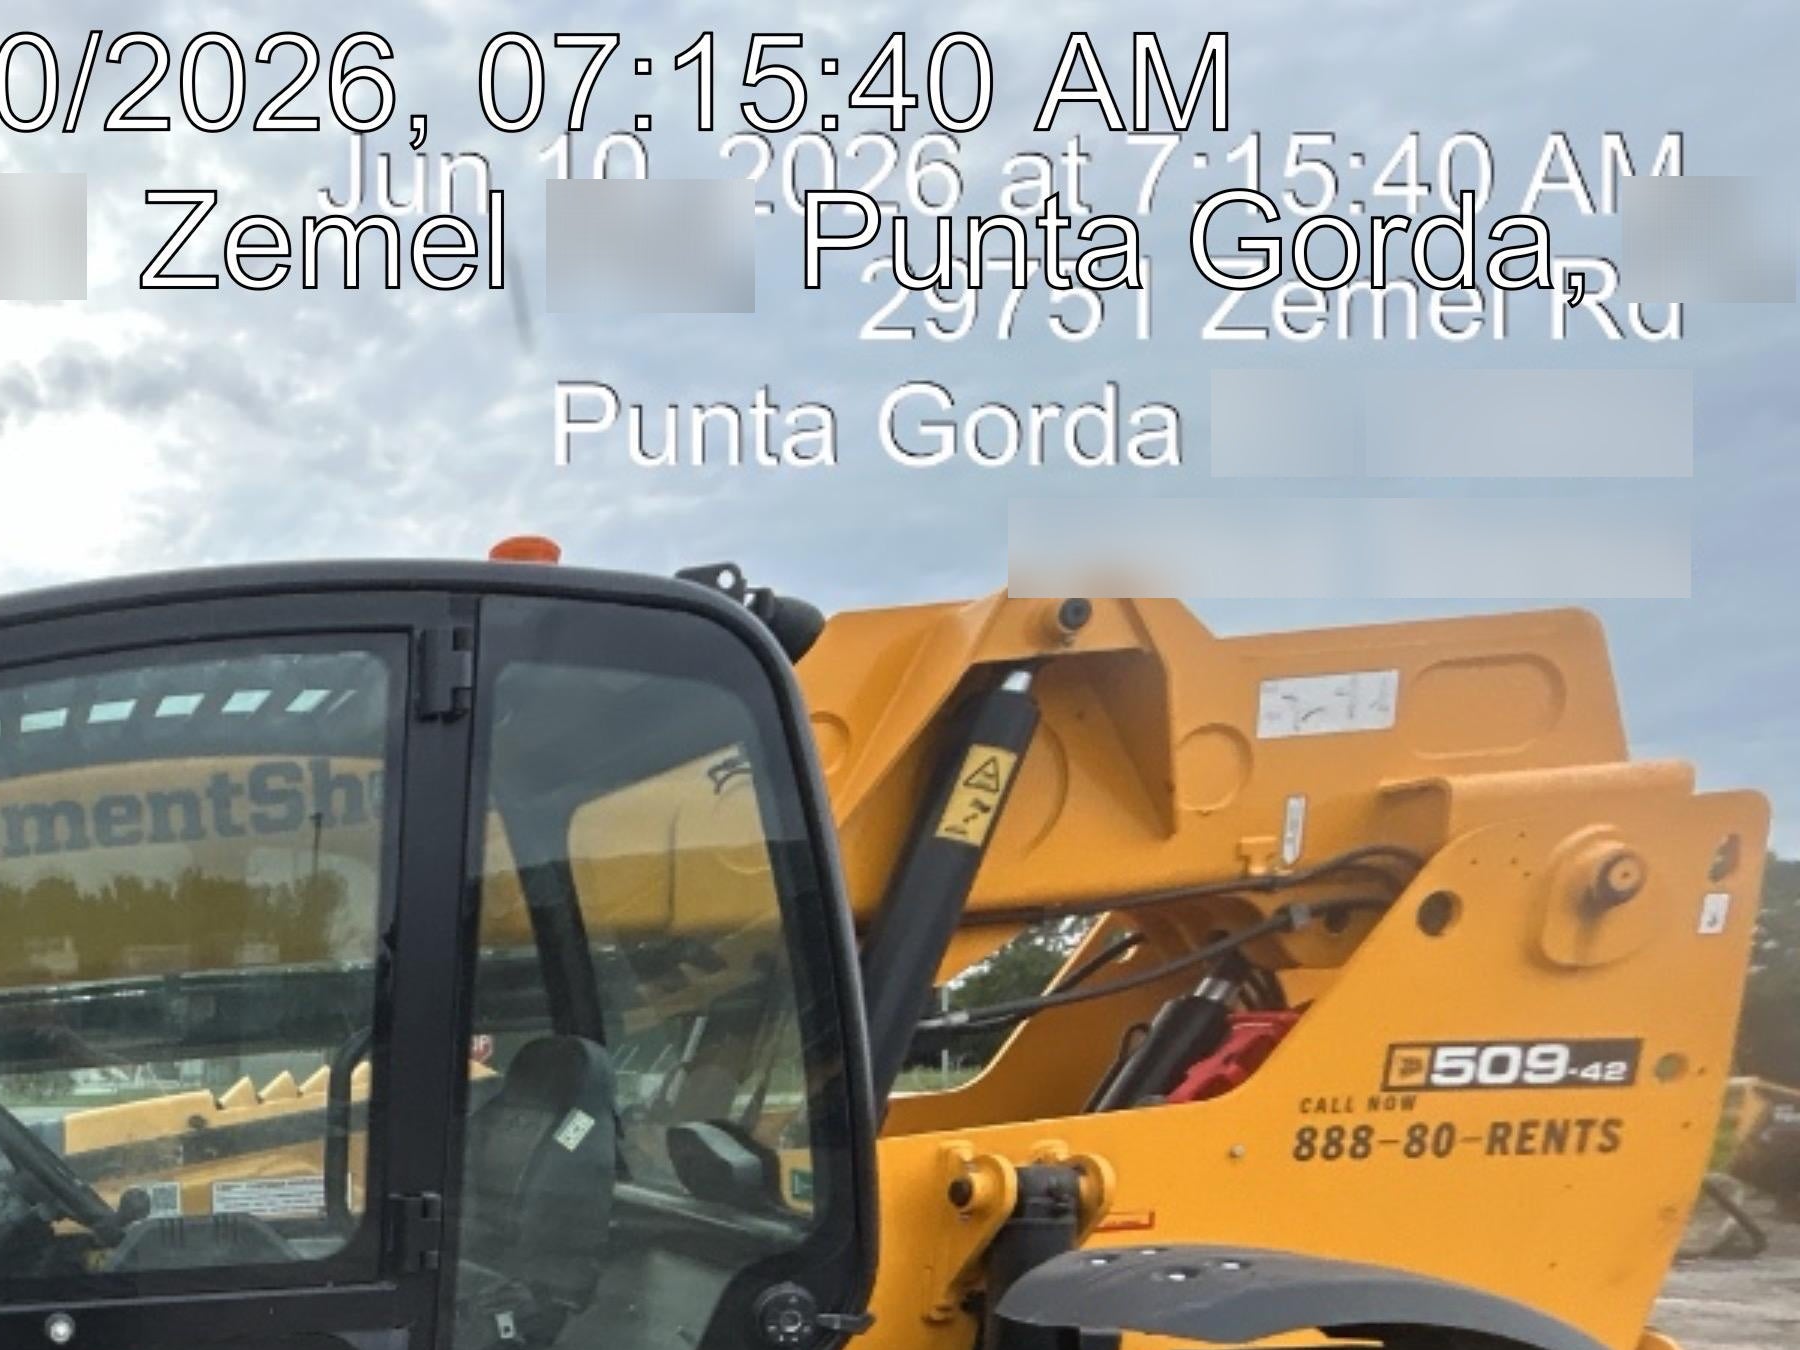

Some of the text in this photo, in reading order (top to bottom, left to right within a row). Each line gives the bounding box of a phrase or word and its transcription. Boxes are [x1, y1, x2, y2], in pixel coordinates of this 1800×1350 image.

[1430, 1043, 1627, 1086] 509-42
[1299, 1095, 1417, 1114] CALL NOW
